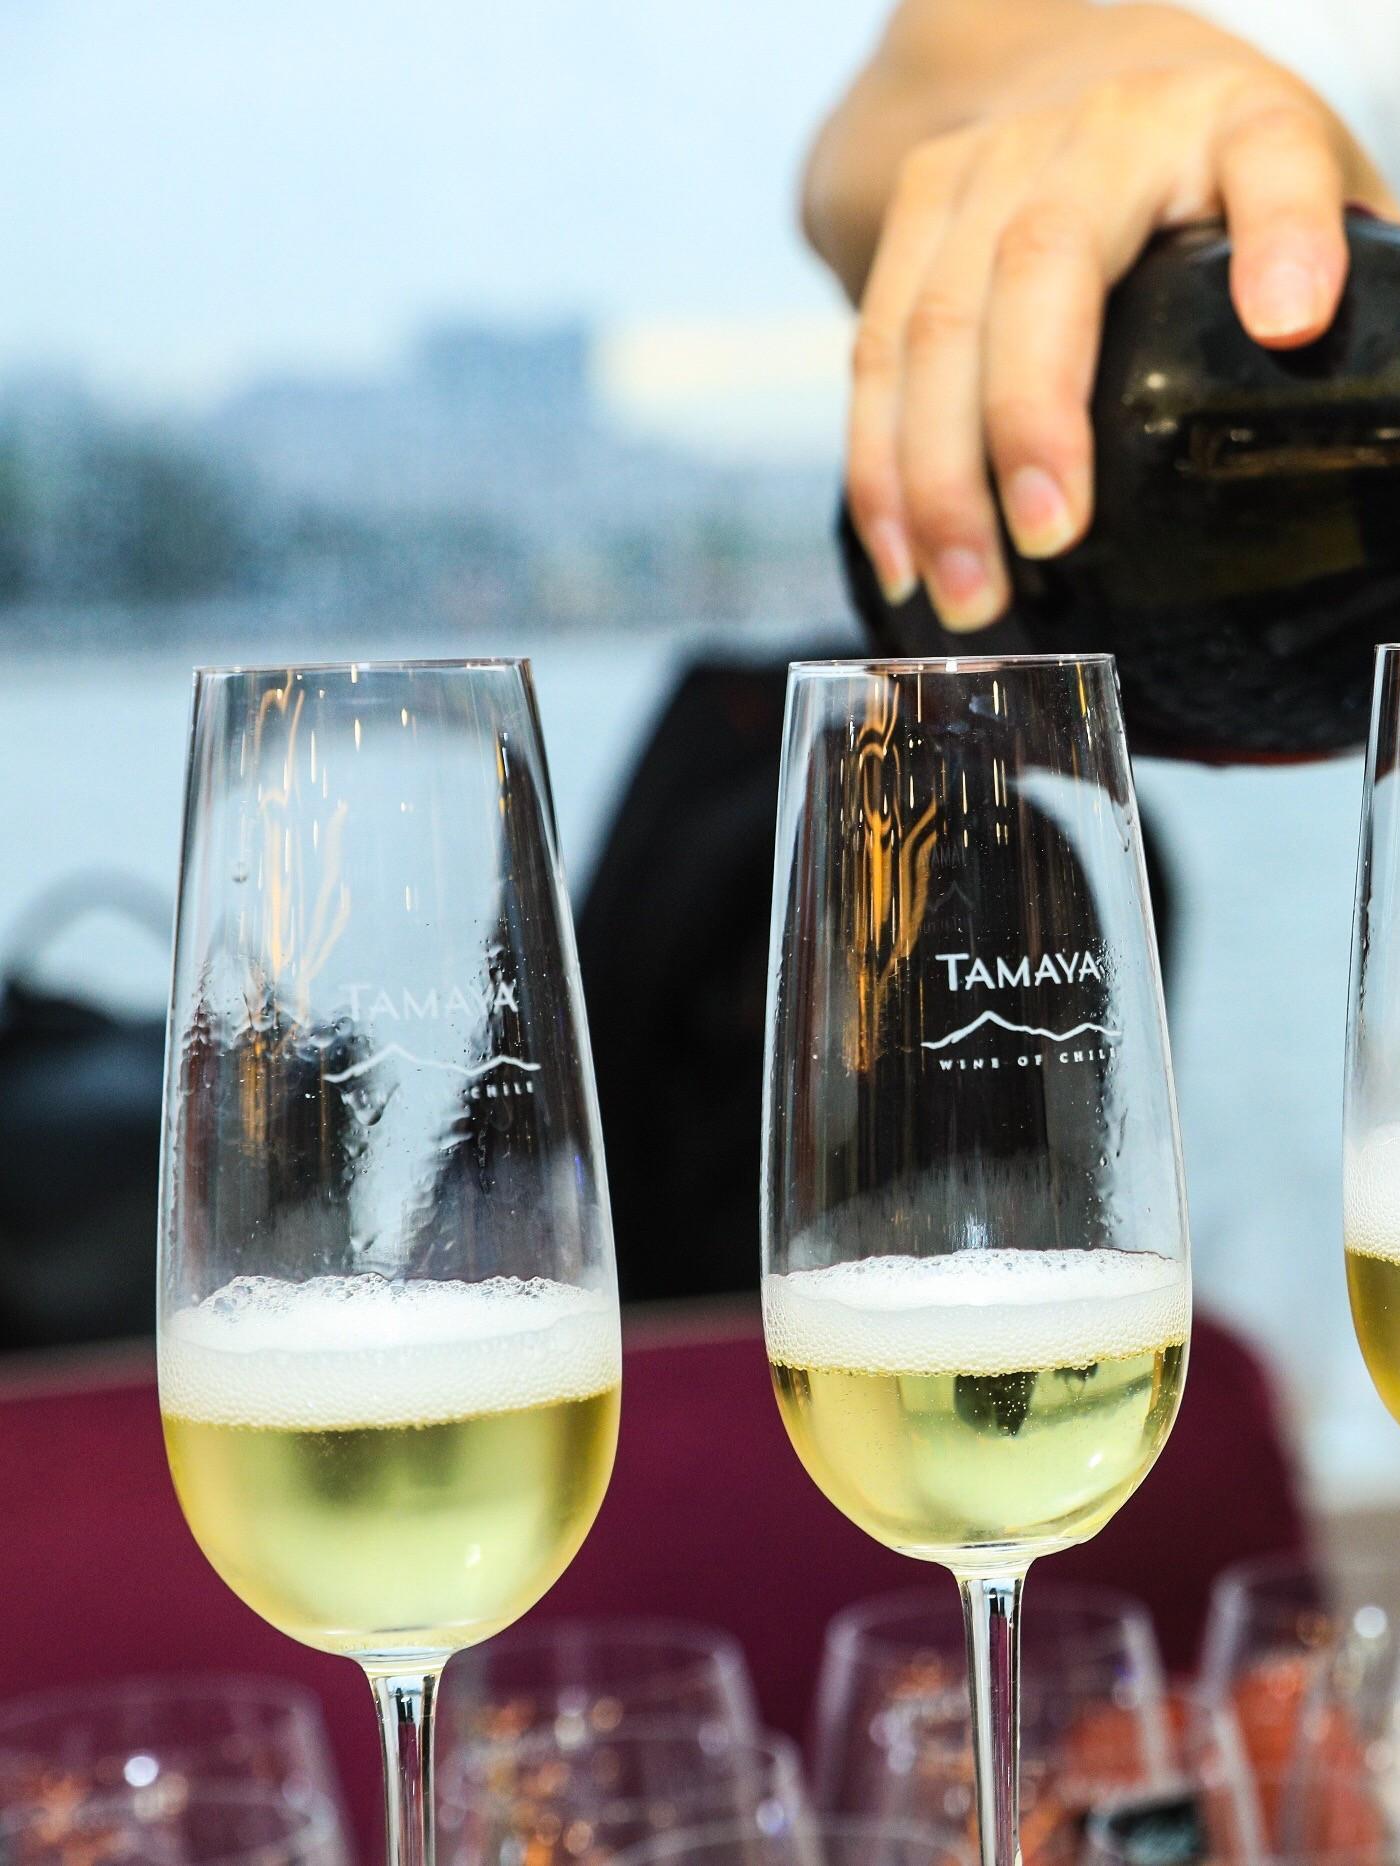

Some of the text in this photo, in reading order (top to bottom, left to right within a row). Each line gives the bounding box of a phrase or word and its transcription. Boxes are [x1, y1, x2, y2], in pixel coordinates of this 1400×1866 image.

[935, 950, 1101, 991] TAMAYA
[337, 979, 518, 1021] TAMAYA
[939, 1056, 1000, 1071] WINE
